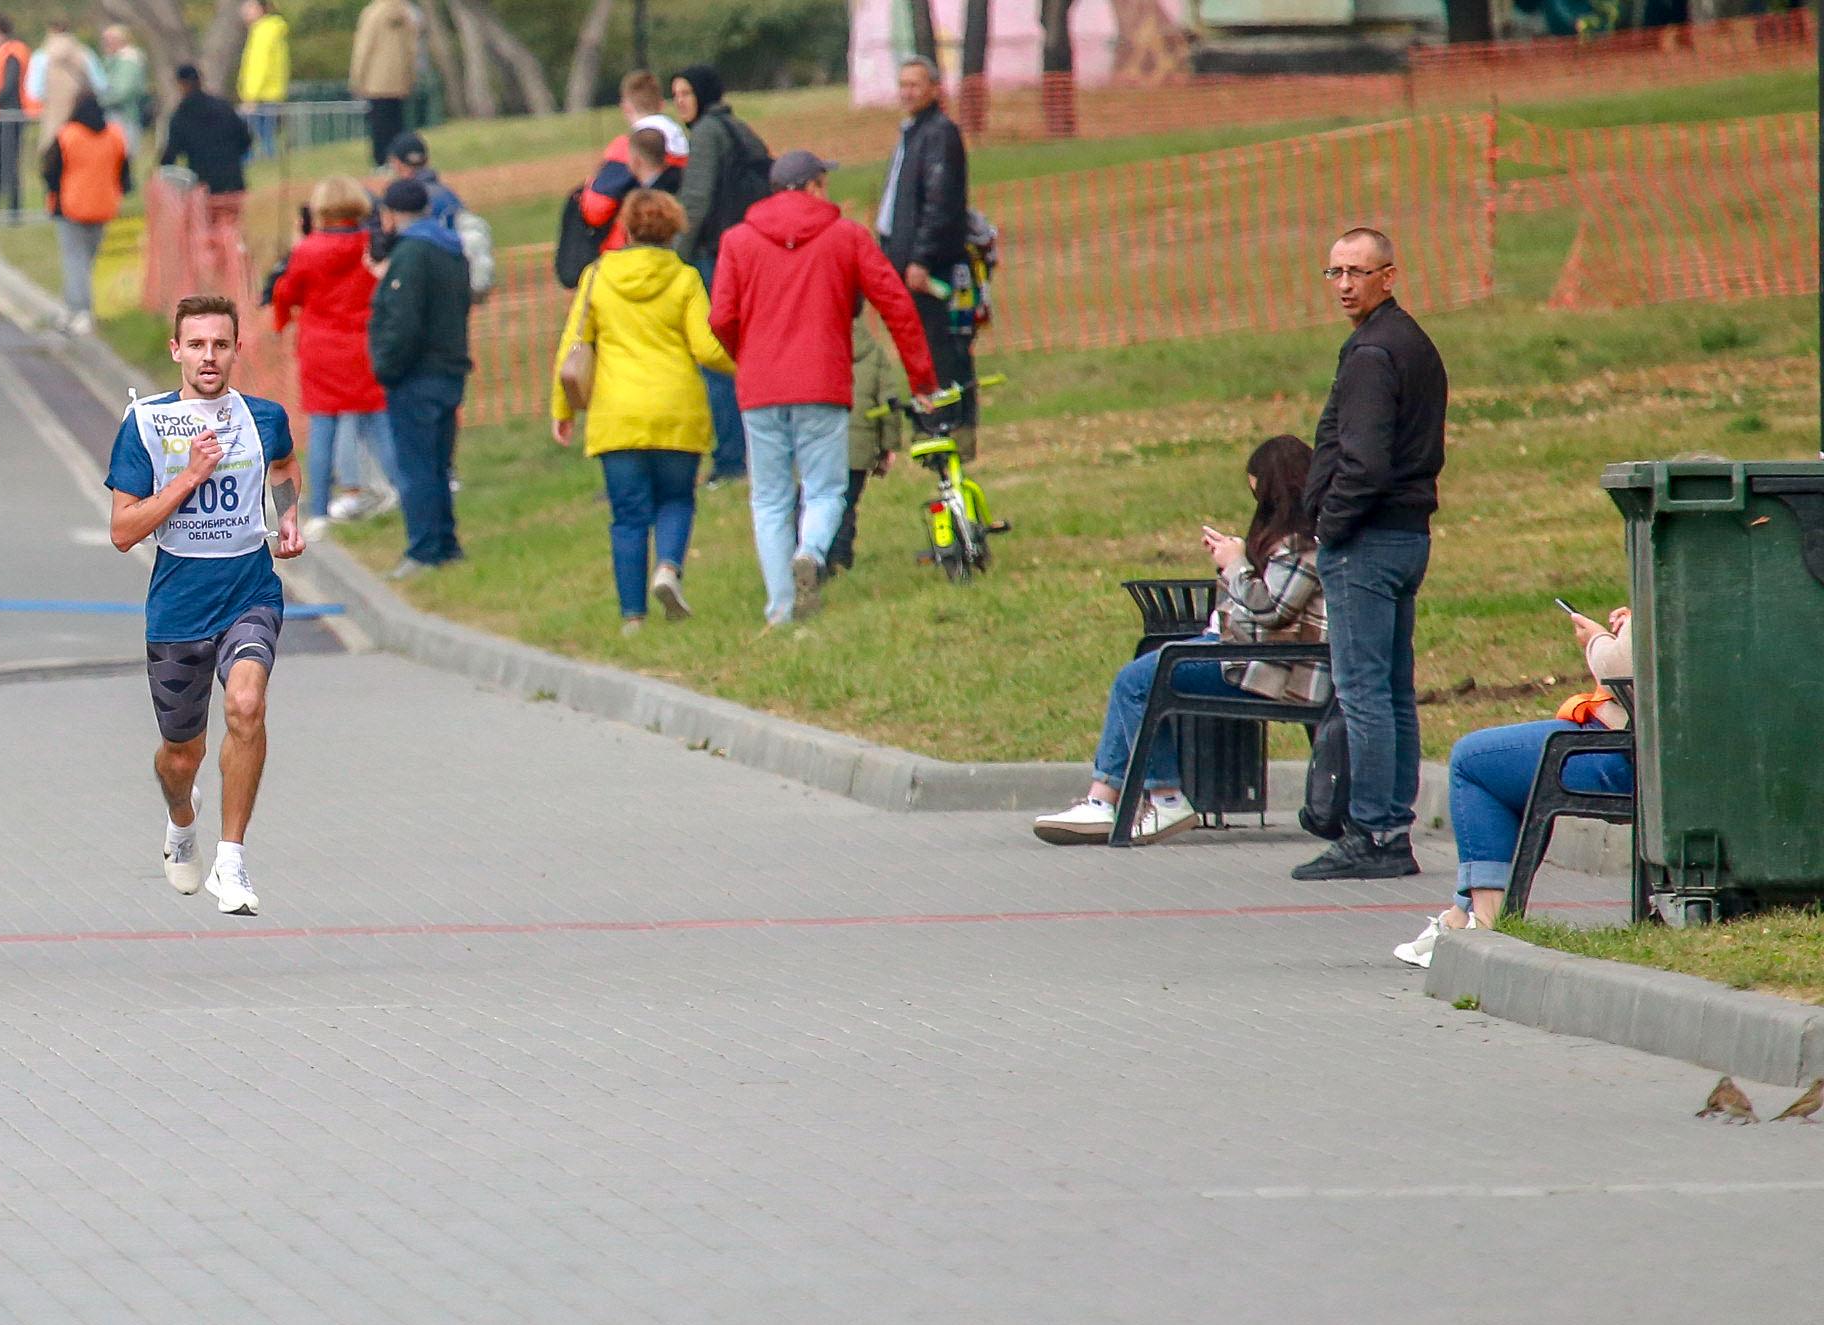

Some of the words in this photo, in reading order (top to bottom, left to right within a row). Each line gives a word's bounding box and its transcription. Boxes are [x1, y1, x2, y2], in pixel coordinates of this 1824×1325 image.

[152, 413, 193, 426] КРОСС
[178, 475, 240, 514] 208
[168, 515, 250, 529] НОВОСИБИРСКАЯ
[188, 530, 232, 541] ОБЛАСТЬ
